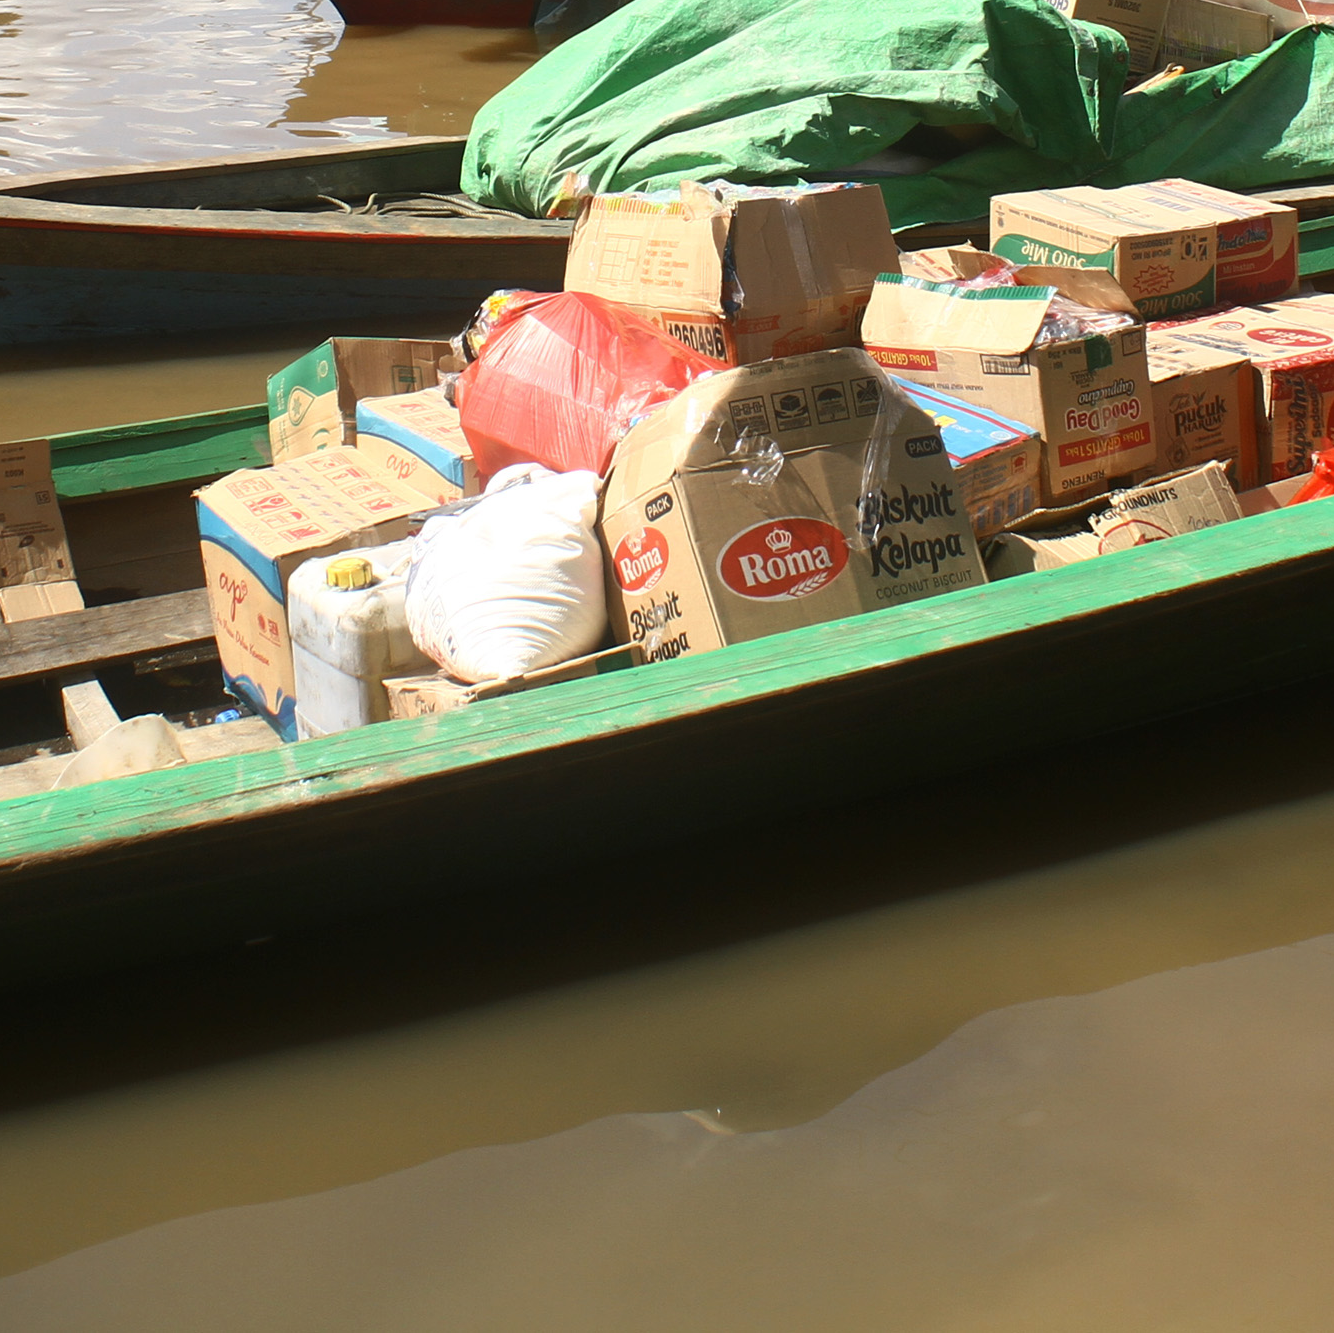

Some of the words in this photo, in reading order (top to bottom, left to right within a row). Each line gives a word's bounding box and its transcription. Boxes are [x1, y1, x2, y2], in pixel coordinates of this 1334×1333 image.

[1077, 377, 1135, 406] Cappuccino
[1064, 408, 1101, 433] Day
[1103, 396, 1141, 428] Good
[909, 439, 940, 454] PACK
[1084, 435, 1121, 455] GRATIS
[1061, 469, 1105, 490] RENTENG
[645, 495, 670, 520] PACK
[855, 482, 957, 534] Biskuit
[619, 545, 663, 583] Roma
[739, 543, 834, 588] Roma
[870, 532, 965, 580] Kelapa
[876, 578, 931, 601] COCONUT
[933, 569, 972, 589] BISCUIT
